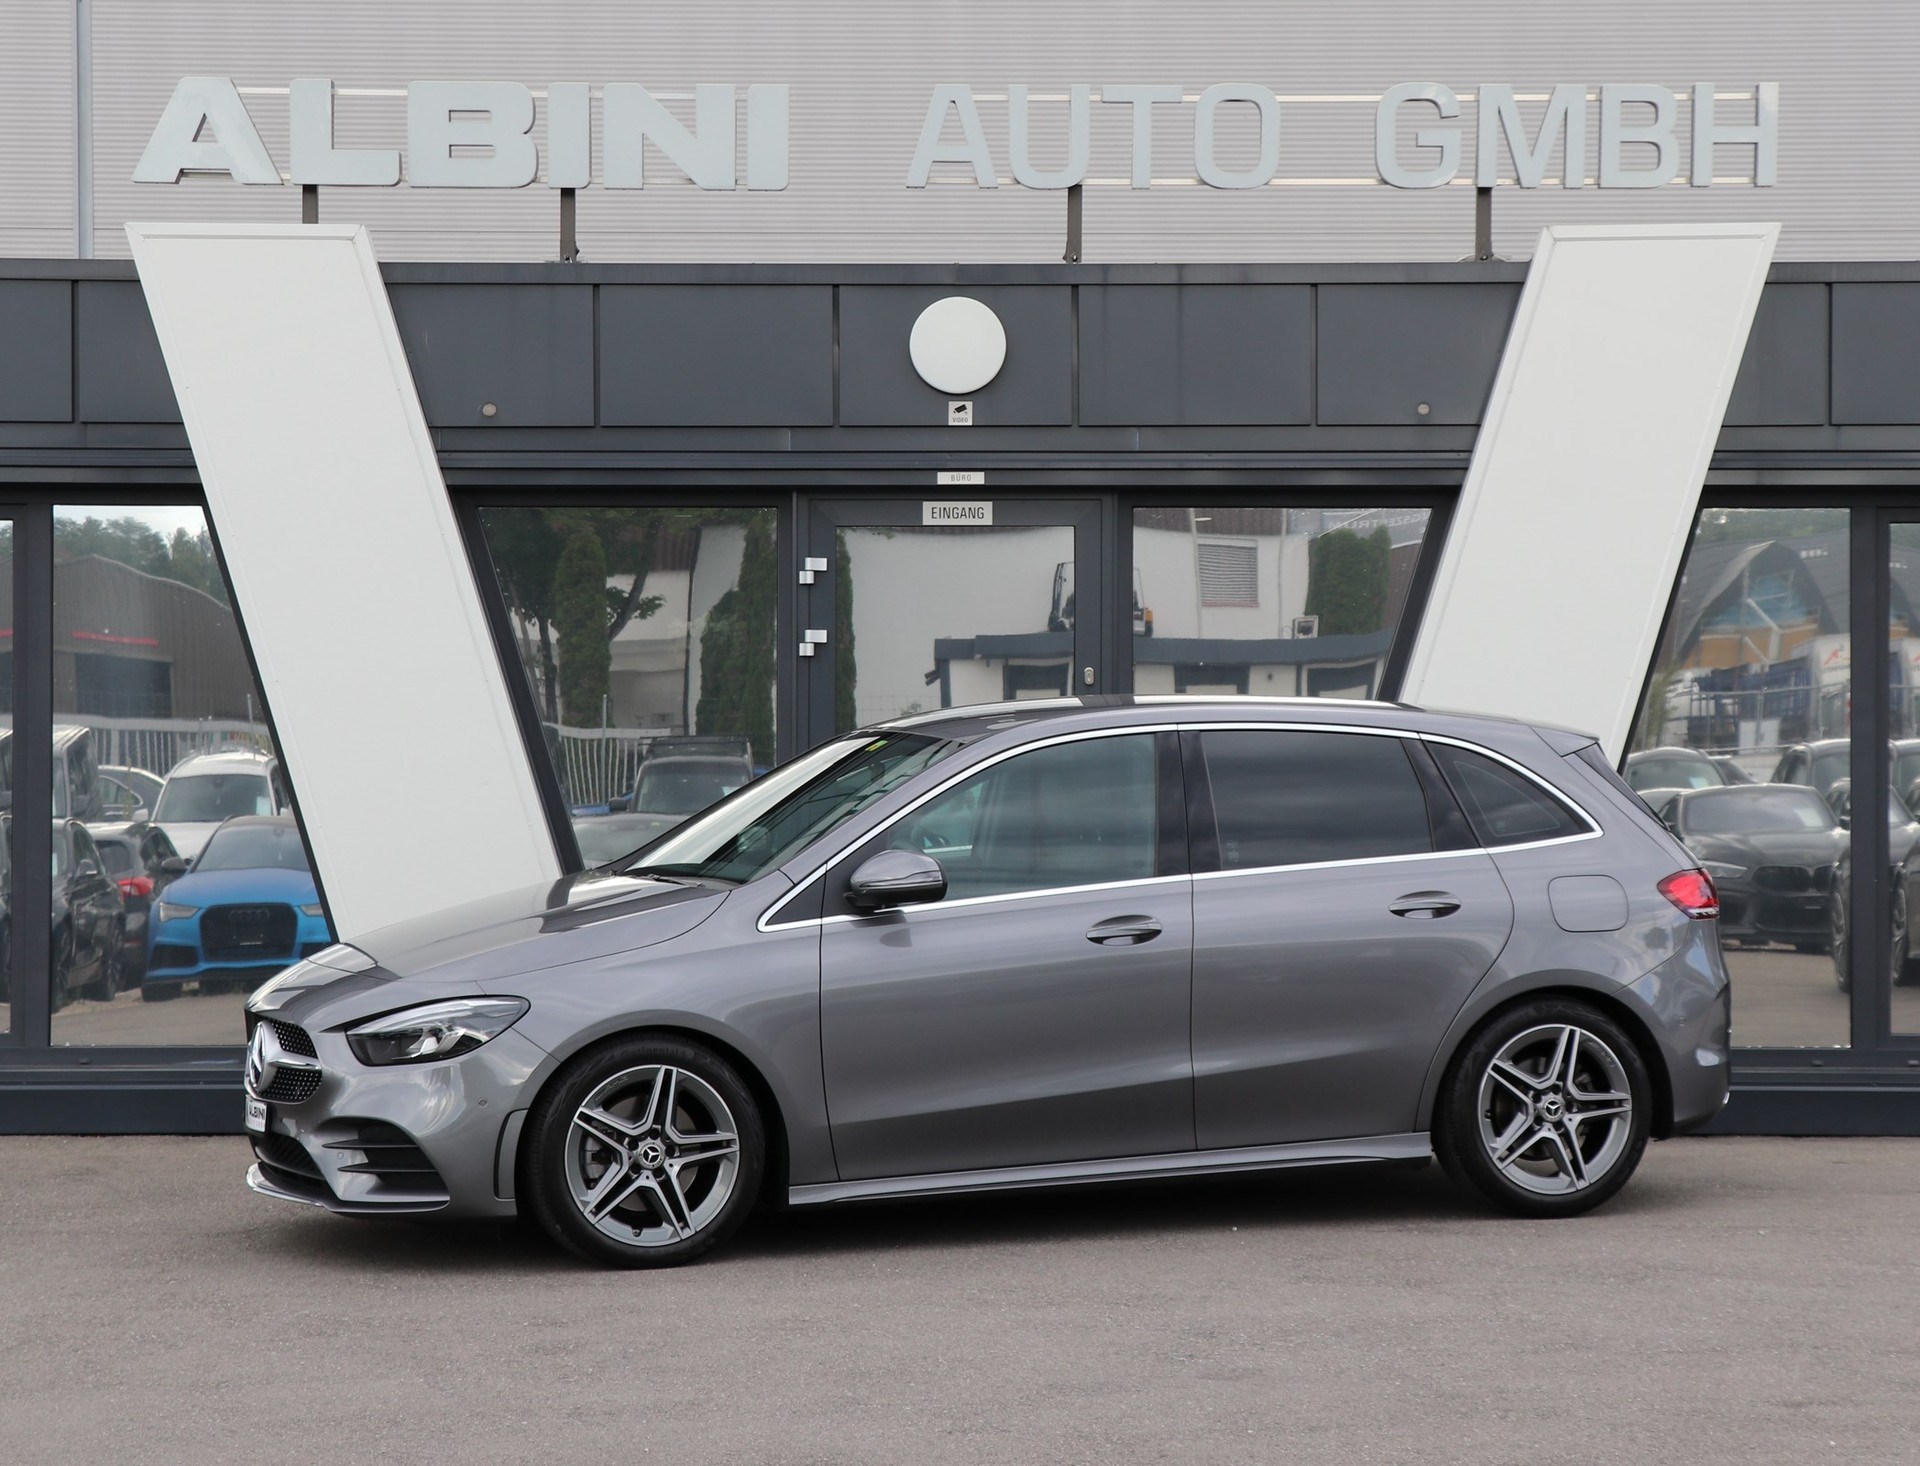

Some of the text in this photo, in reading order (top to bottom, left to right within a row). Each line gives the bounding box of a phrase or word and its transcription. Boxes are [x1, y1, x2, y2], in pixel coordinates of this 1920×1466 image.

[131, 76, 1780, 191] ALBINI AUTO GMBH
[950, 473, 972, 482] BÜRO
[931, 506, 985, 519] EINGANG
